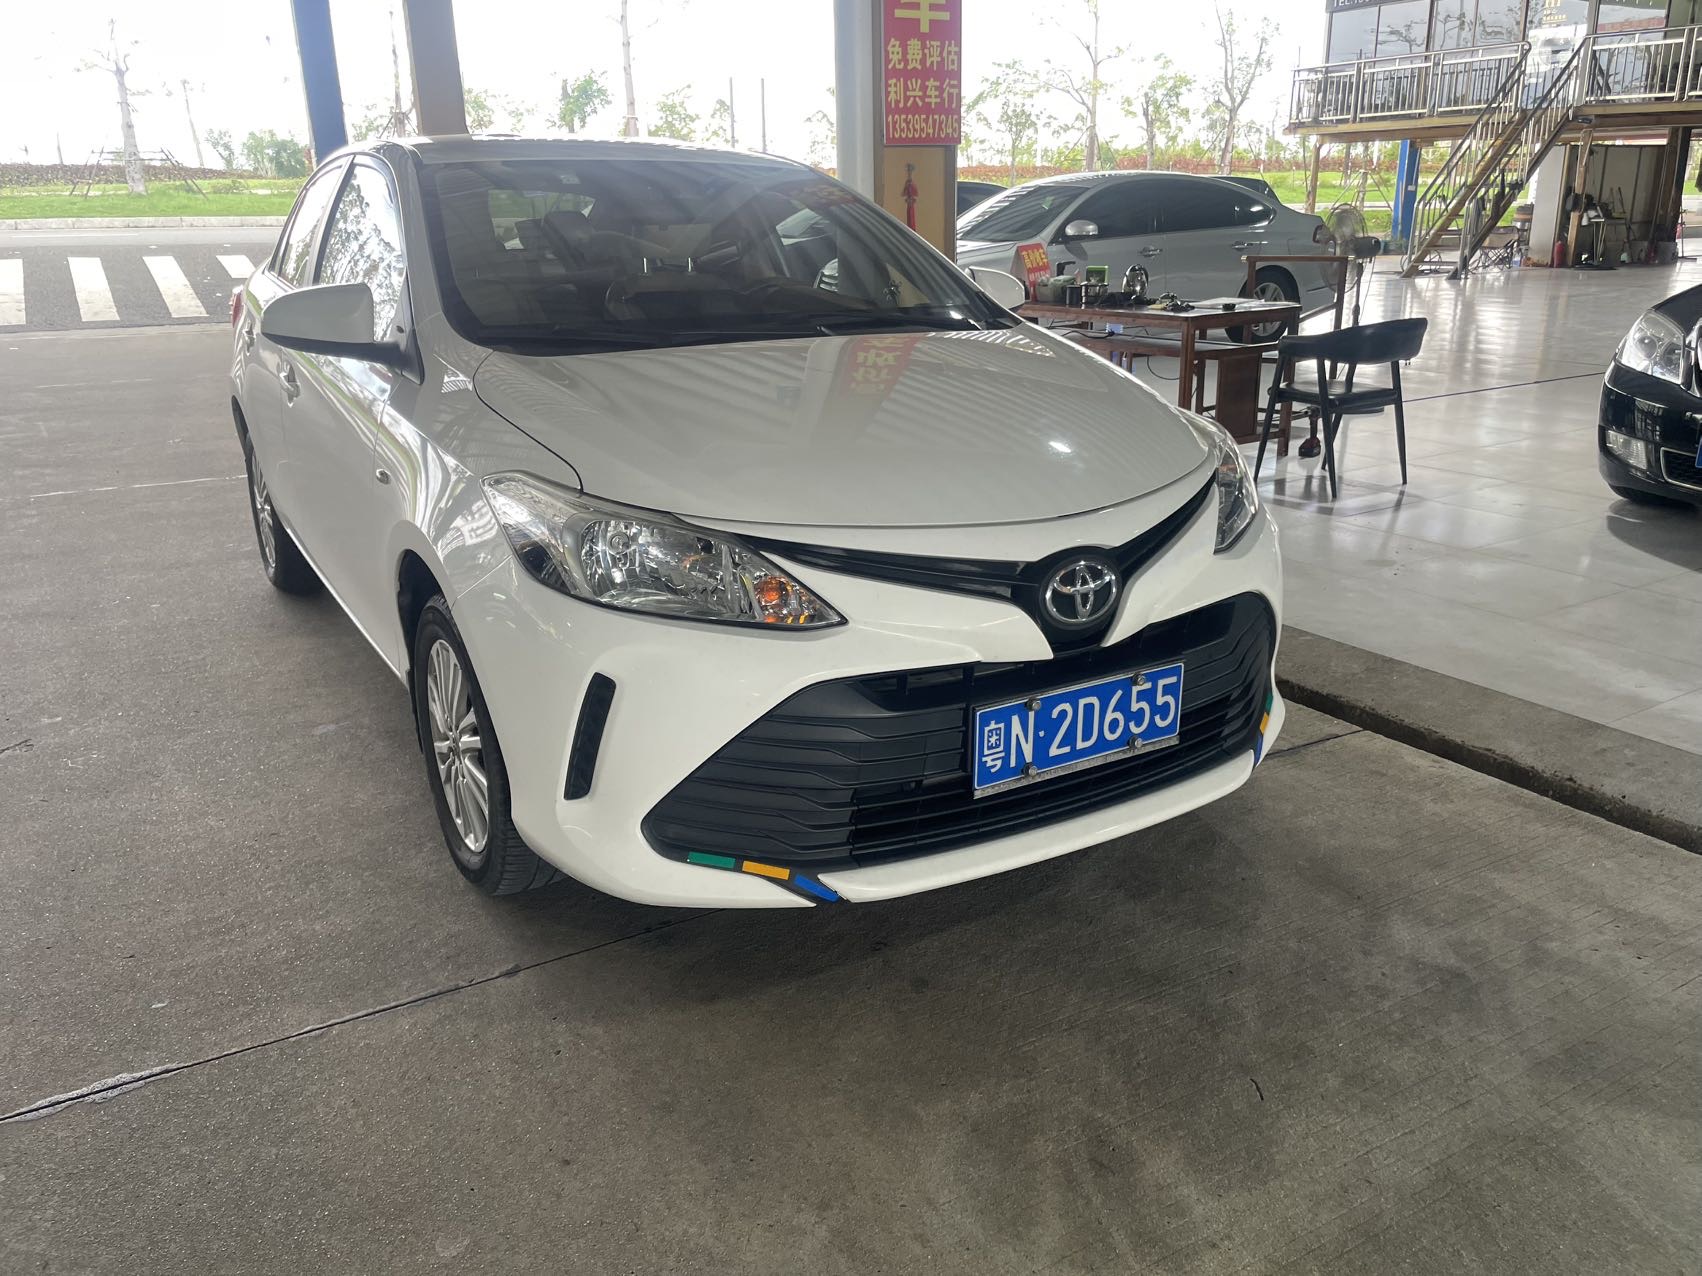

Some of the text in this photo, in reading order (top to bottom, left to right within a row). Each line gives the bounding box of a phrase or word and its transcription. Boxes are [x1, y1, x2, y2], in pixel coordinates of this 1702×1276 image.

[887, 38, 959, 71] 免费评估
[887, 77, 959, 109] 利兴车行
[887, 114, 959, 139] 13539547345
[981, 675, 1178, 773] 粤N·2D655
